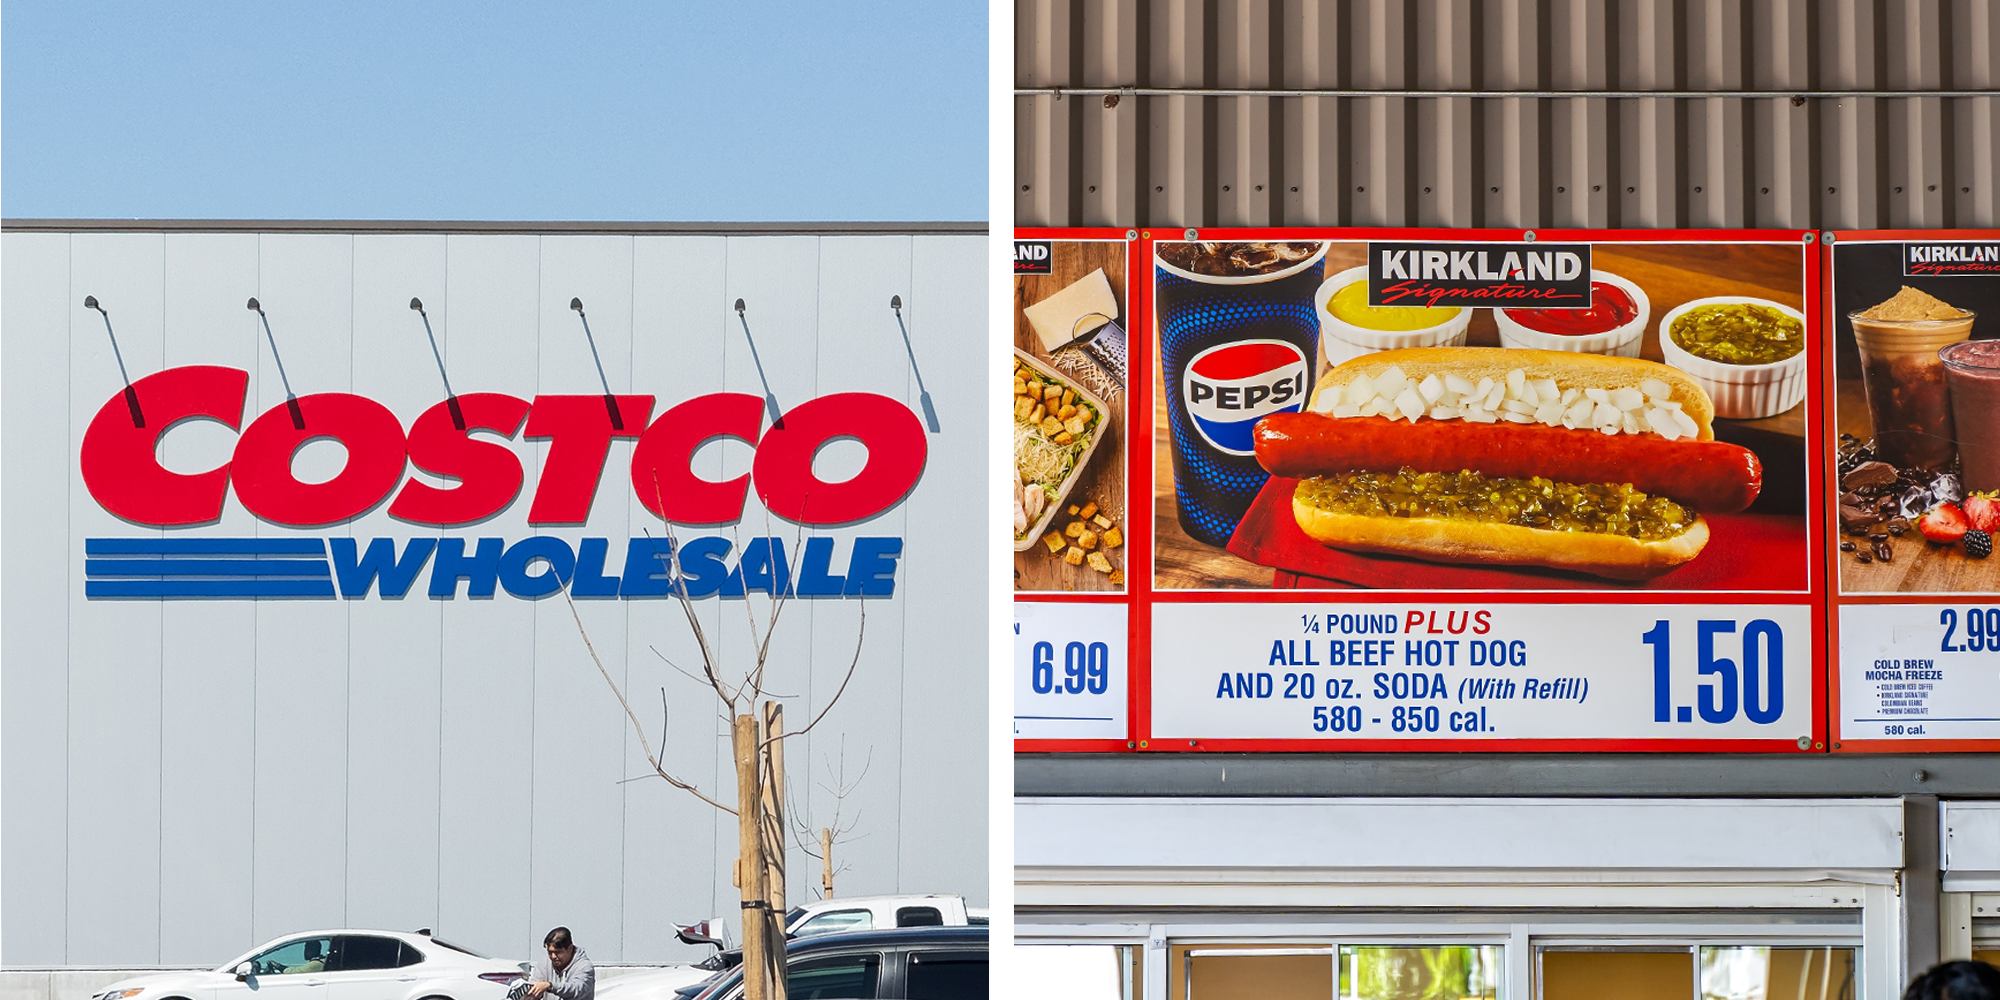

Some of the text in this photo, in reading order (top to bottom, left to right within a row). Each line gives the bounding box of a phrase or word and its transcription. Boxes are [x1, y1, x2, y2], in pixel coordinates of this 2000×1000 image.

[1381, 249, 1583, 281] KIRKLAND
[1910, 246, 2000, 262] KIRKLAN
[1381, 280, 1583, 309] Signature
[1189, 370, 1303, 410] PEPSI
[80, 365, 928, 528] COSTCO
[329, 536, 903, 600] WHOLESALE
[1326, 614, 1398, 635] POUND
[1404, 610, 1492, 635] PLUS
[1940, 608, 2000, 652] 2.99
[1032, 641, 1109, 695] 6.99
[1268, 640, 1527, 667] ALL BEEF HOT DOG
[1874, 659, 1934, 670] COLD BREW
[1642, 619, 1784, 724] 1.50
[1865, 670, 1943, 681] MOCHA FREEZE
[1216, 672, 1589, 705] AND 20 oz. SODA (With Refill)
[1313, 705, 1362, 733] 580
[1391, 705, 1440, 733] 850
[1449, 705, 1495, 733] cal.
[1885, 724, 1926, 735] 580 cal.
